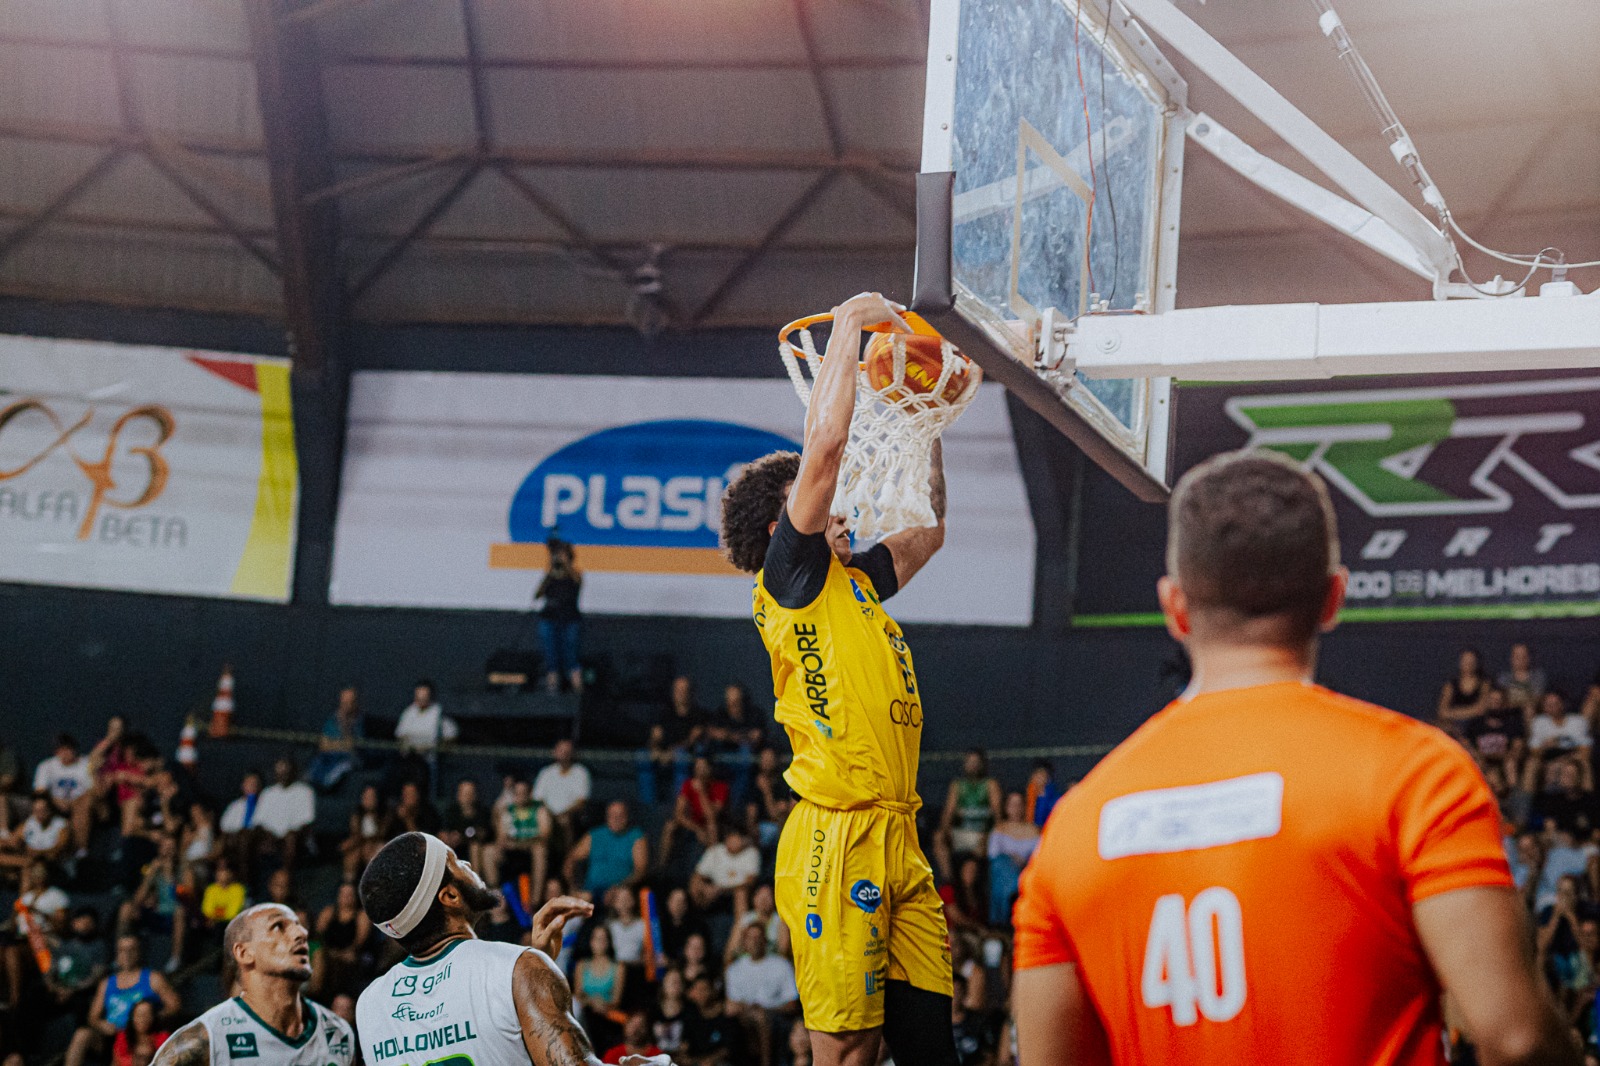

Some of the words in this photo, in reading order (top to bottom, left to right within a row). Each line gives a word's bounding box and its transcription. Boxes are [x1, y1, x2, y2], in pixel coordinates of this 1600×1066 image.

[102, 513, 188, 548] BETA
[794, 623, 830, 720] ARBORE
[889, 699, 924, 729] OSC
[1141, 885, 1247, 1027] 40
[422, 962, 453, 995] gali
[408, 1002, 444, 1022] Euro17
[372, 1020, 477, 1063] HOLLOWELL
